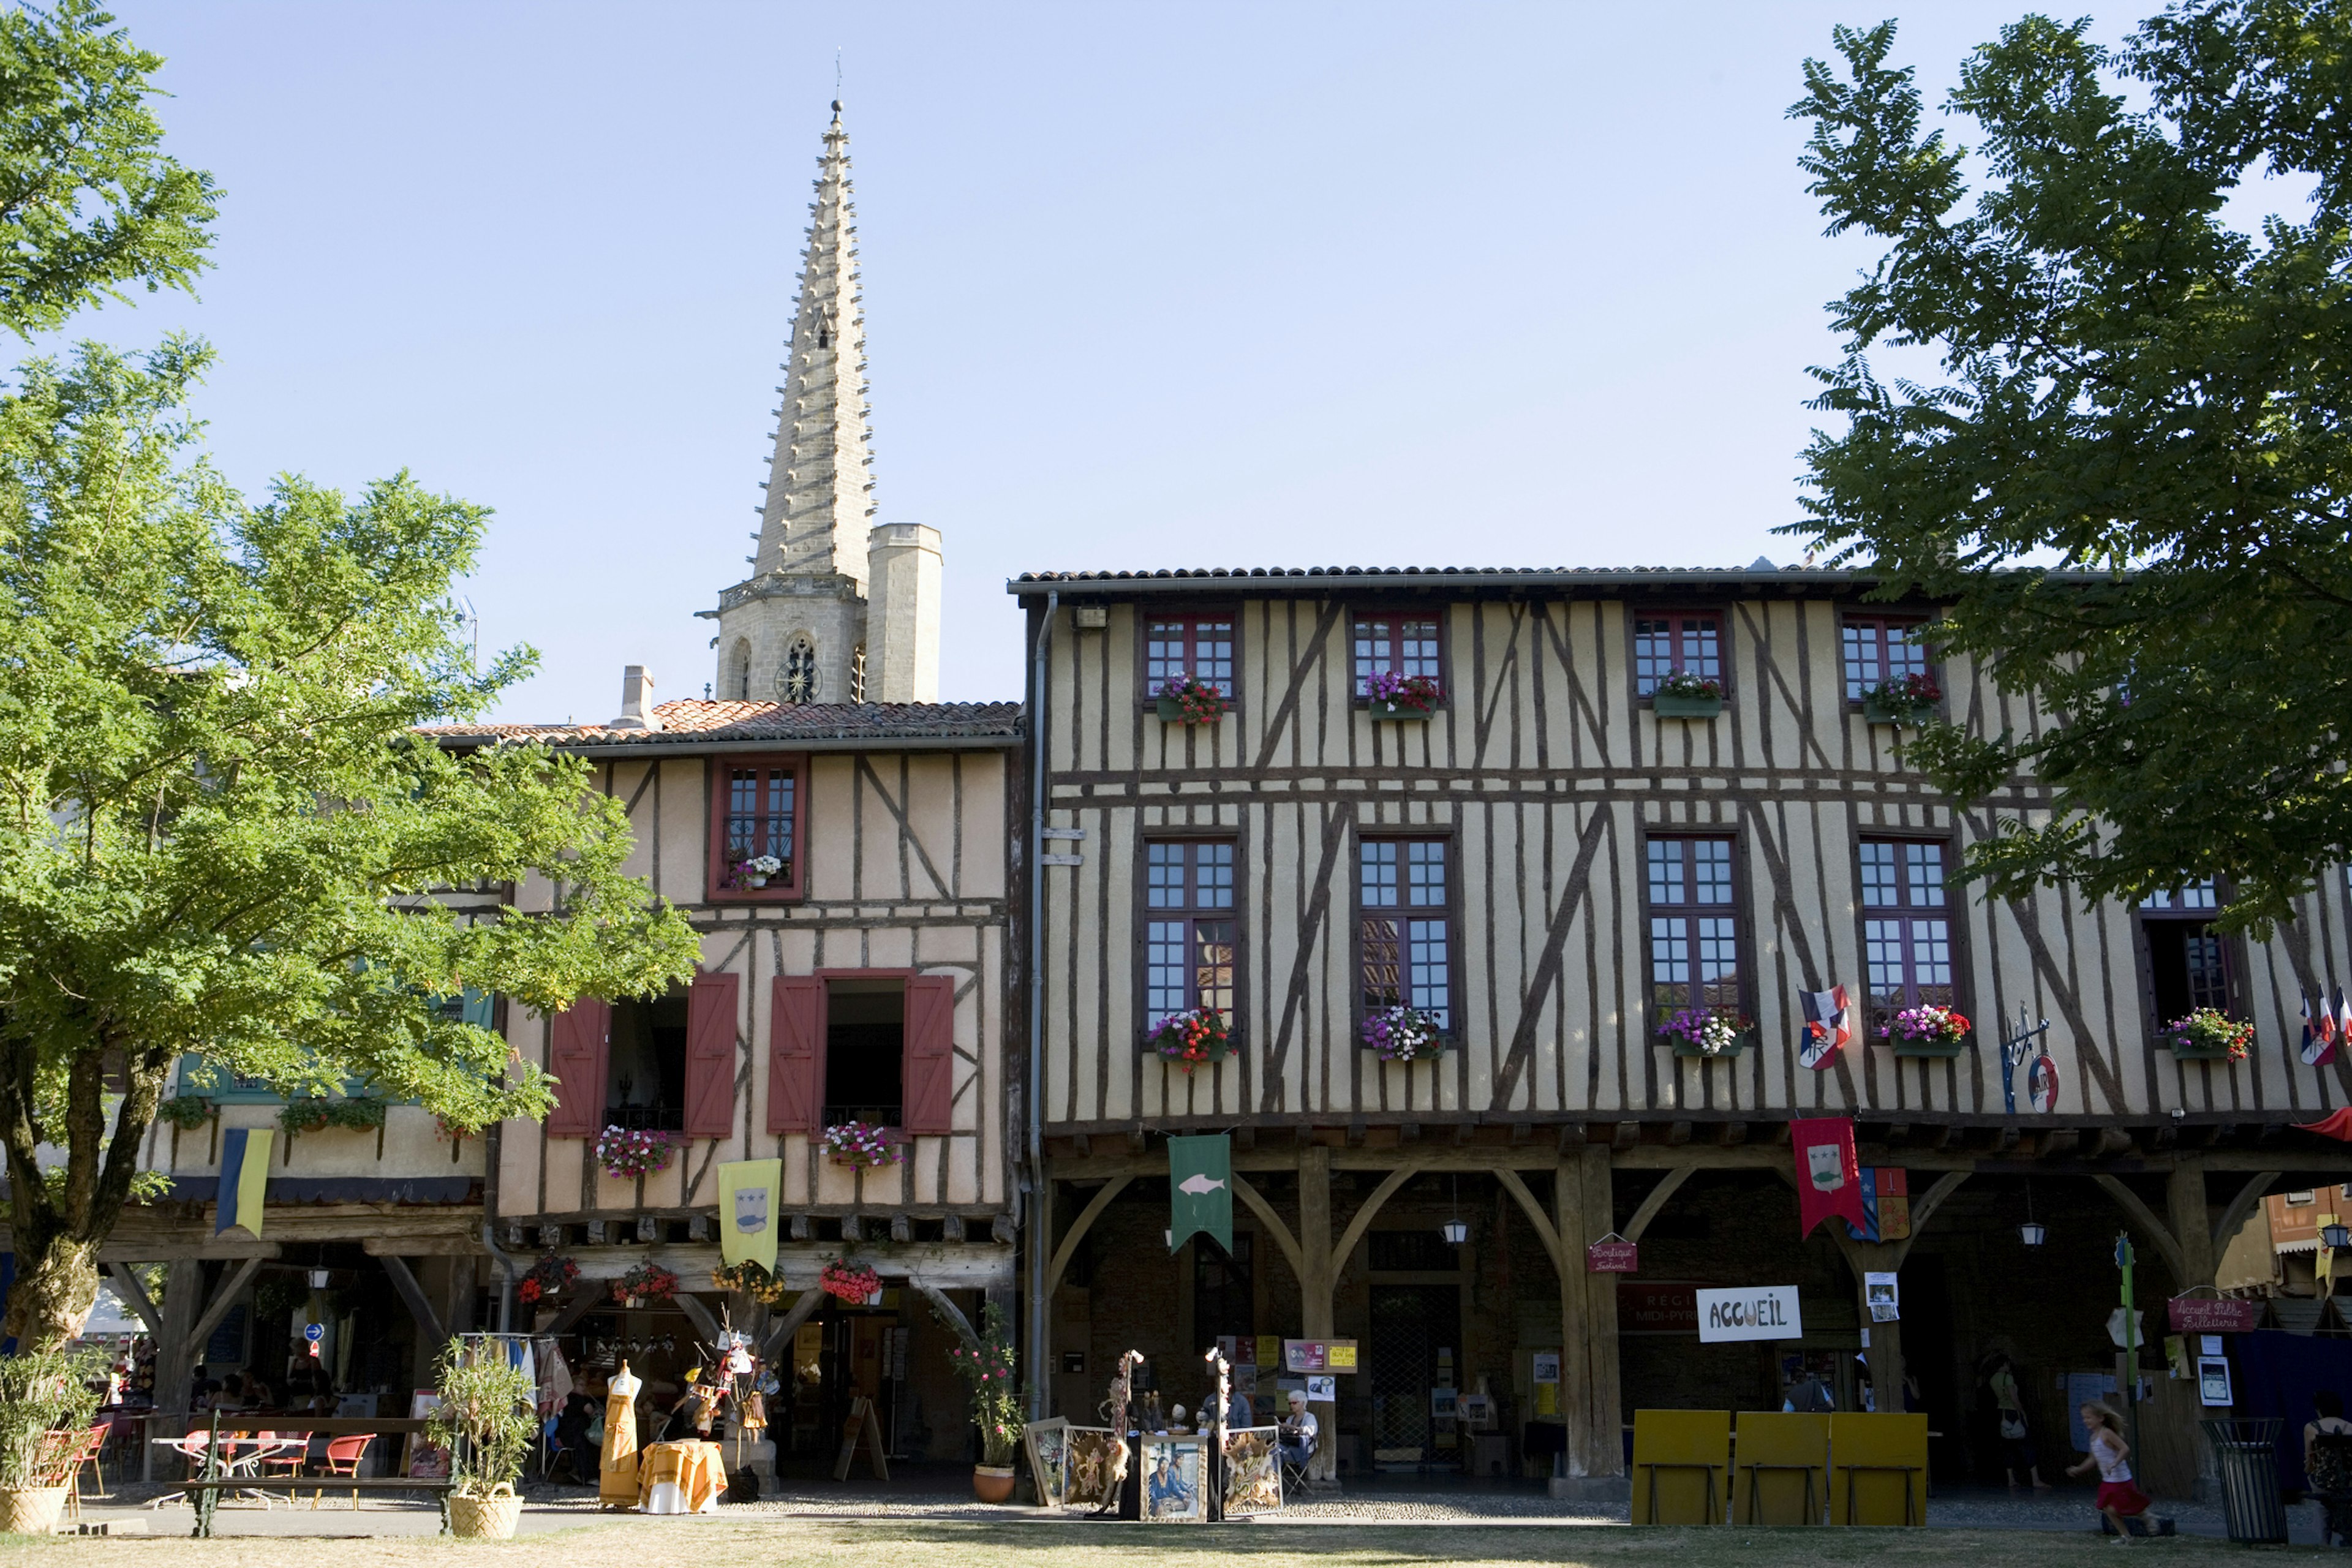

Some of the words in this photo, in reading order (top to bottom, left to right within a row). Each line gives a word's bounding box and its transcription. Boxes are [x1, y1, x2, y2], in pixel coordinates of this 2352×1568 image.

[2030, 1069, 2056, 1093] MAIRIE
[1593, 1245, 1632, 1260] Boutique
[1596, 1261, 1627, 1270] Festival
[1646, 1294, 1696, 1306] RÉGI
[2177, 1300, 2211, 1314] Accueil
[2214, 1302, 2242, 1317] Public
[2182, 1315, 2238, 1329] Billetterie
